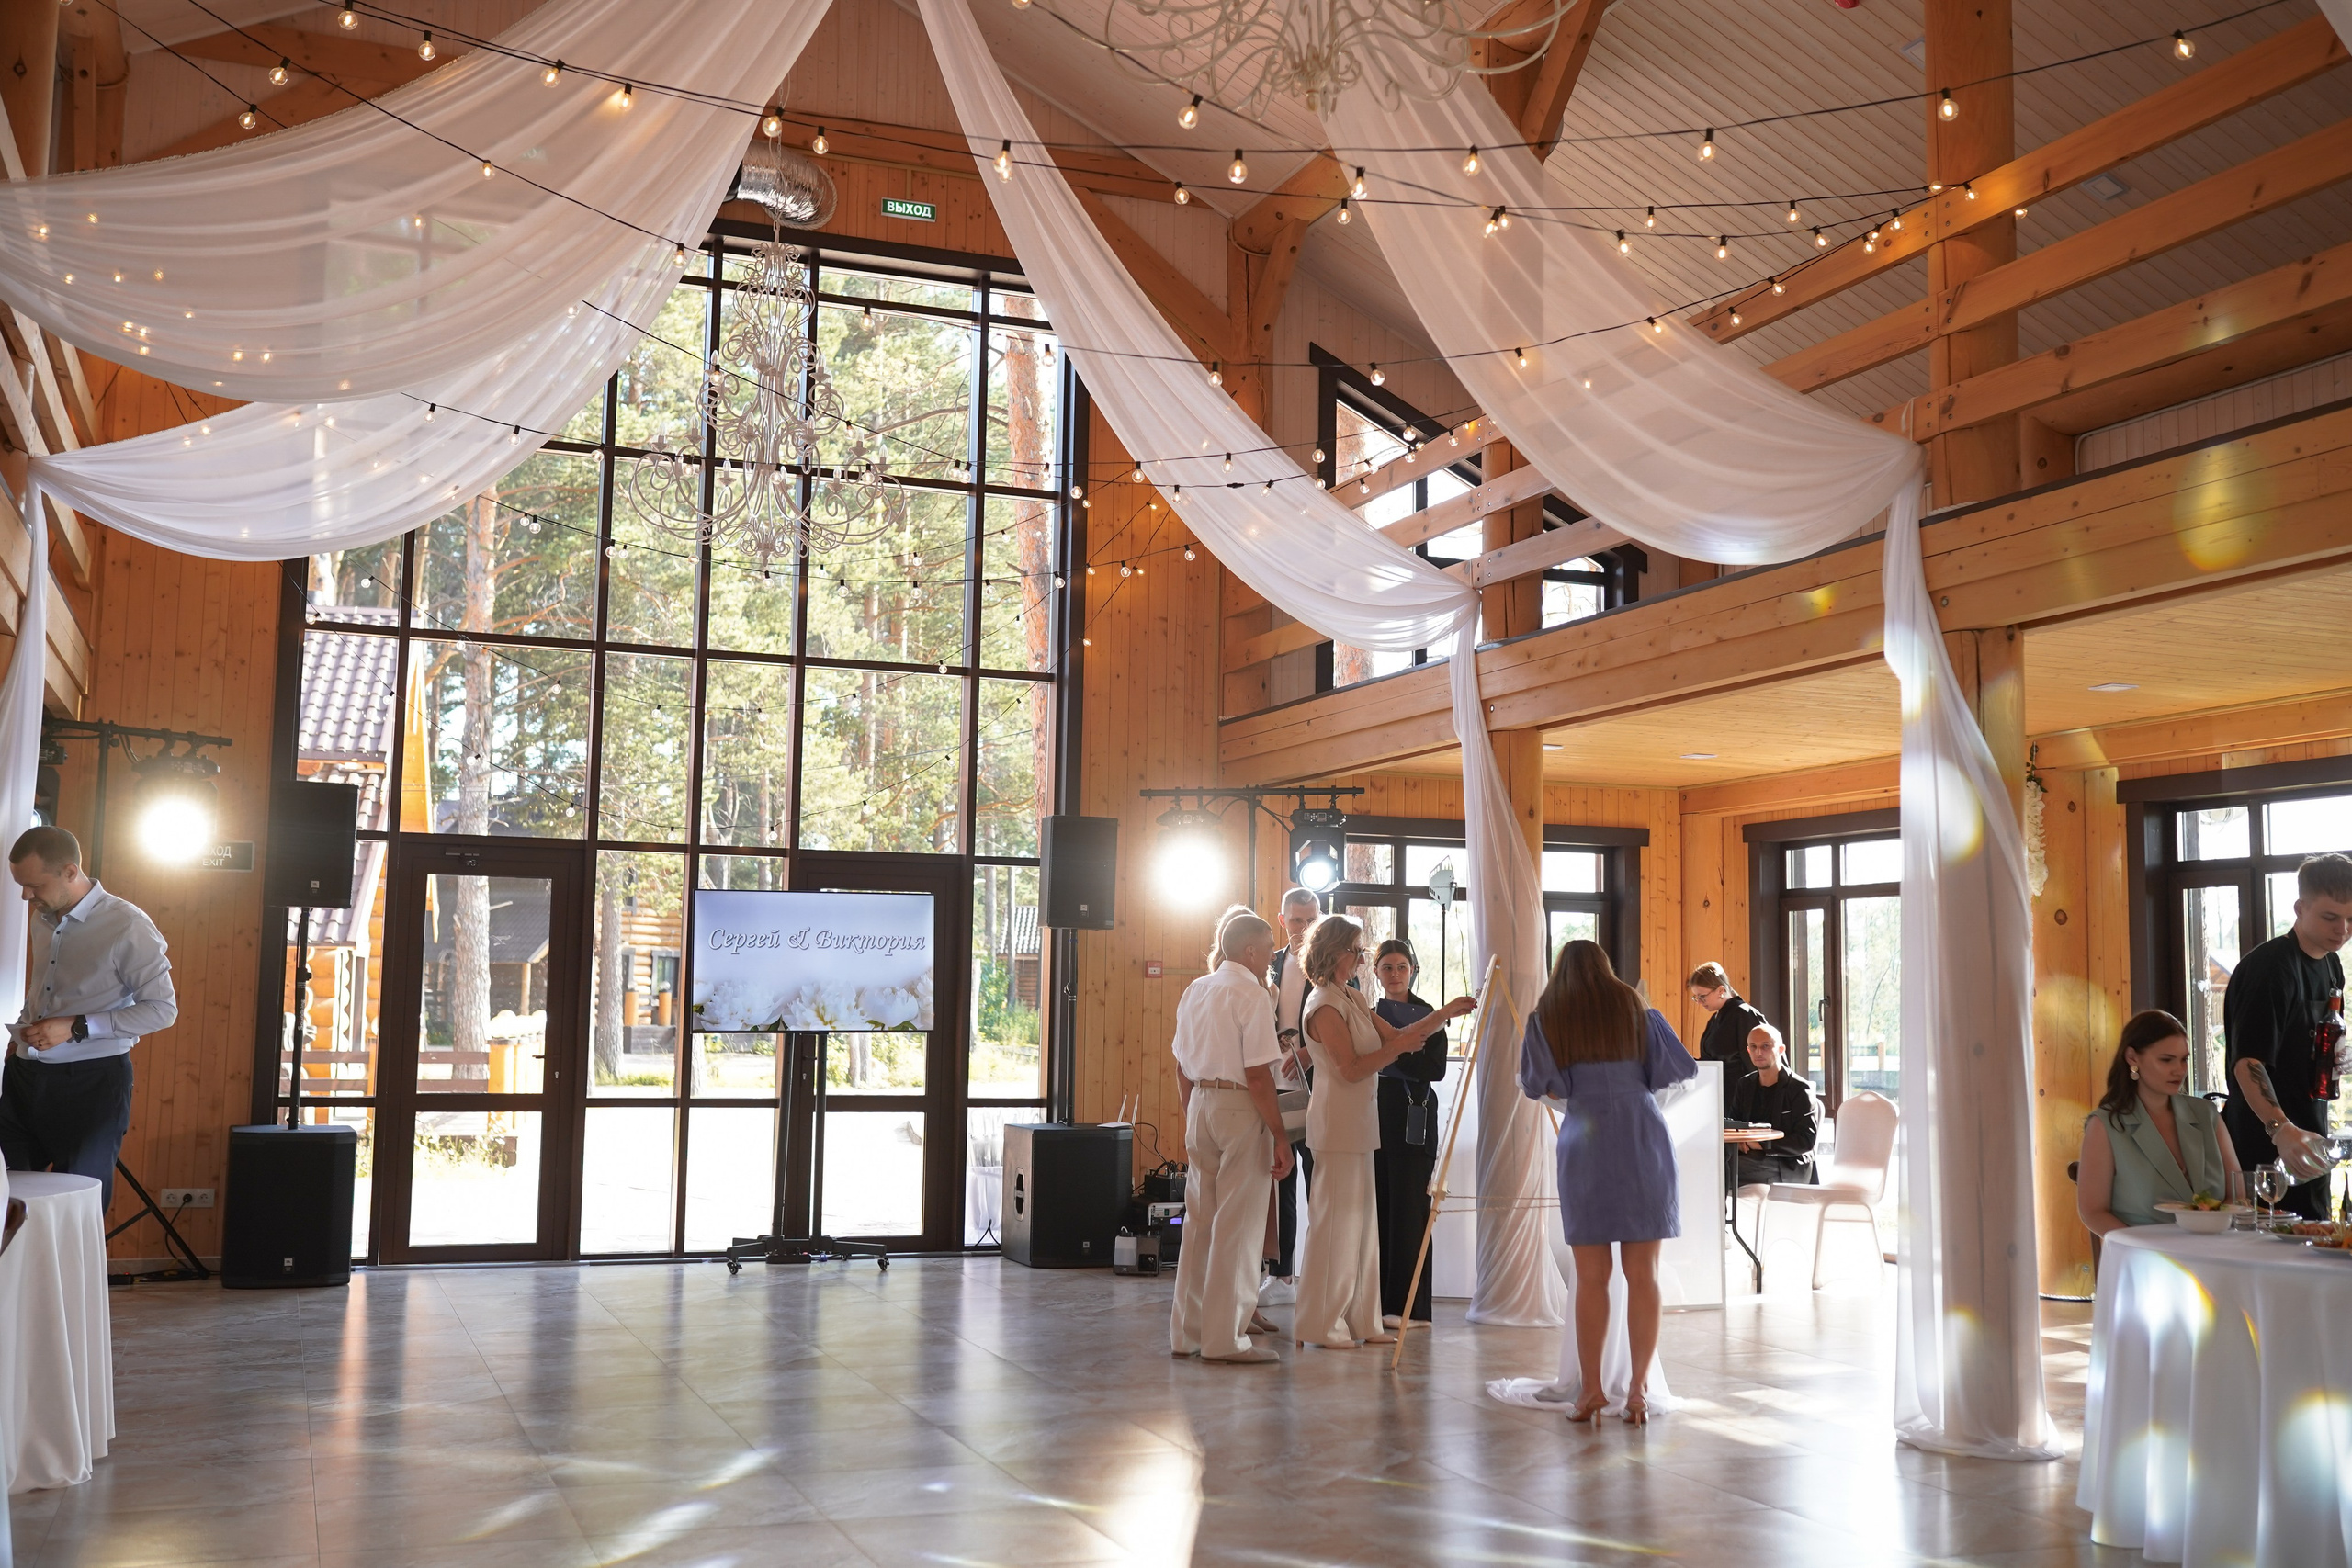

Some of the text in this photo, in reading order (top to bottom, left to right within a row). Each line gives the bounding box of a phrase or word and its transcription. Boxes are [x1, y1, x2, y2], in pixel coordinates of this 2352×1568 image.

[887, 200, 932, 218] ВЫХОД
[200, 845, 232, 858] ХОД
[202, 858, 225, 866] EXIT
[708, 926, 926, 957] Сергей & Виктория
